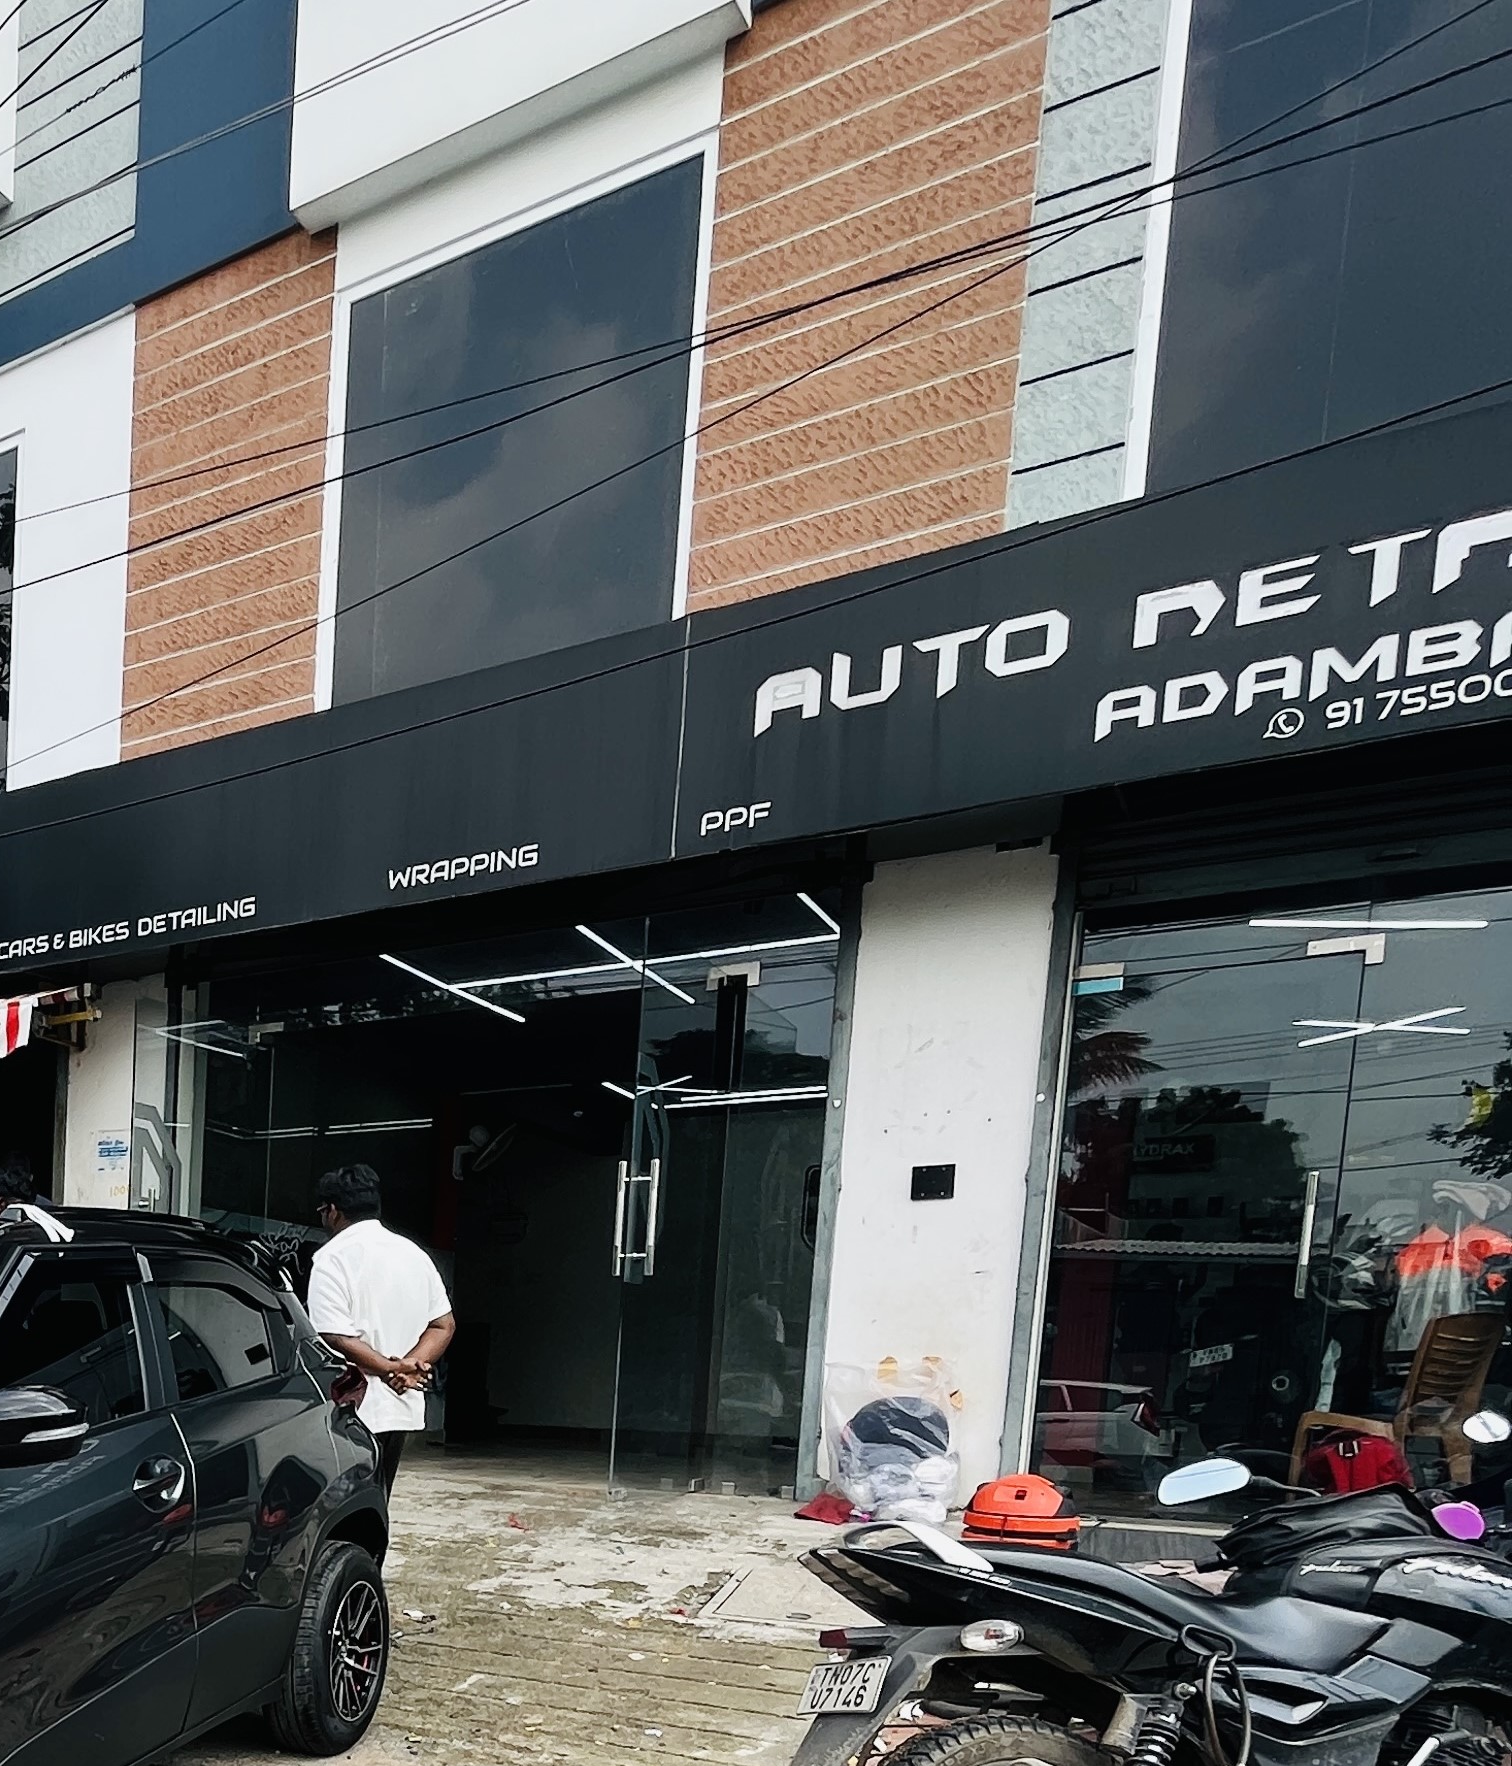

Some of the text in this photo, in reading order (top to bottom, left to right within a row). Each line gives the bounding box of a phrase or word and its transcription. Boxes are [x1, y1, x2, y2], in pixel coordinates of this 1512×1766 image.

[753, 609, 1070, 739] AUTO
[1325, 697, 1364, 730] 91
[700, 801, 772, 837] PPF
[388, 843, 539, 890] WRAPPING
[53, 931, 65, 951] &
[68, 920, 130, 948] BIKES
[136, 896, 256, 937] DETAILING
[810, 1685, 867, 1710] U7146
